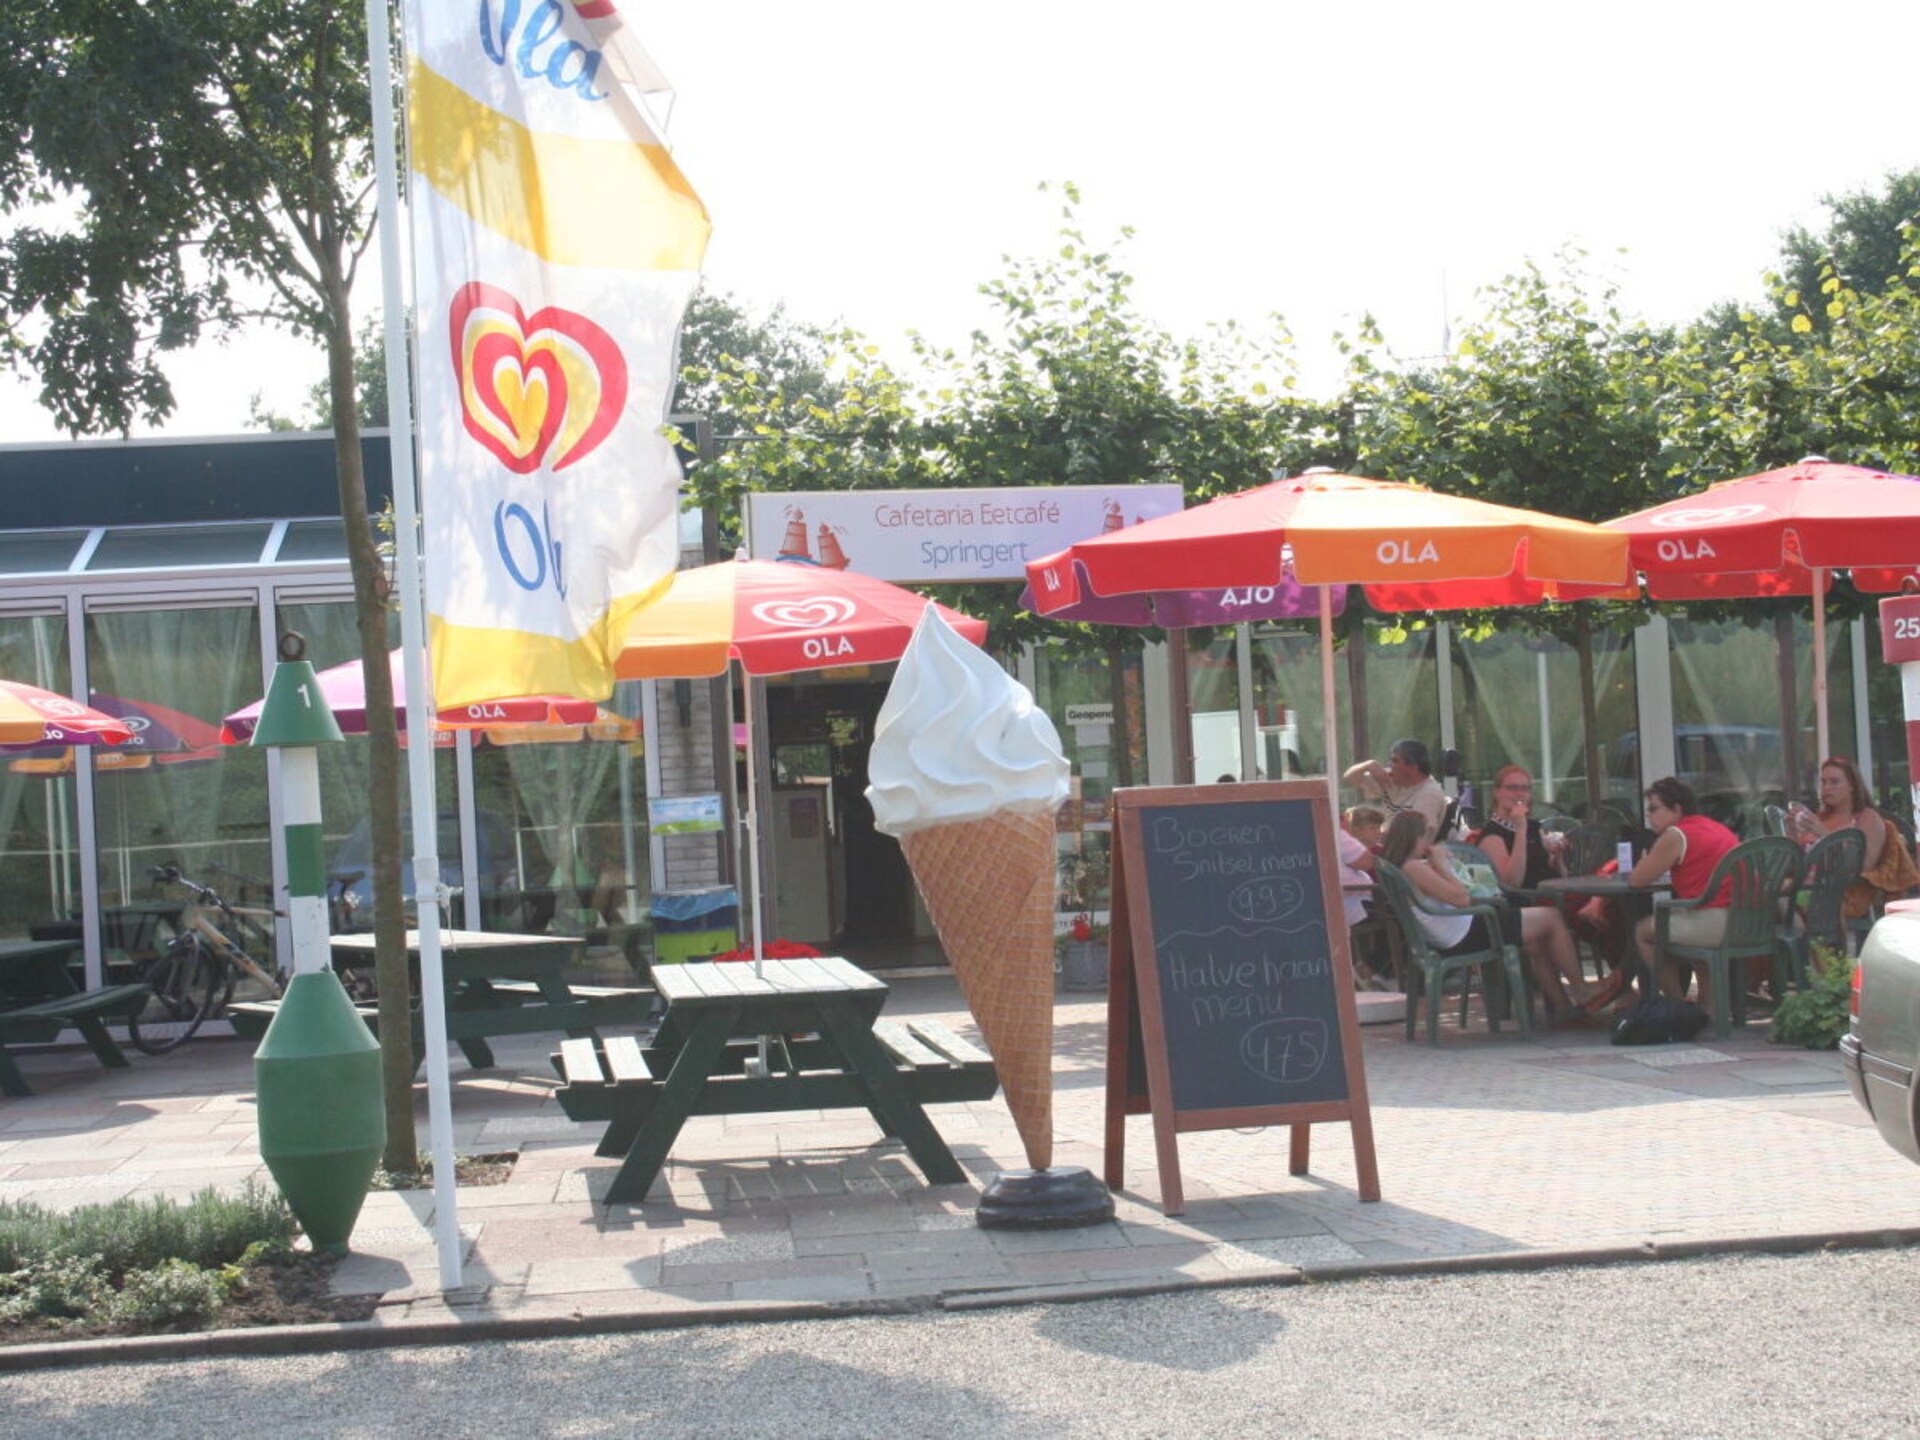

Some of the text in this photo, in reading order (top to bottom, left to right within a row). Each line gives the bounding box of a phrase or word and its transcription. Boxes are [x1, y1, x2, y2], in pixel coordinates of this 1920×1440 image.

[874, 500, 1061, 528] Cafetaria Eetcafé
[921, 540, 1029, 569] Springert
[1376, 540, 1440, 565] OLA
[1657, 539, 1716, 562] OLA
[803, 636, 855, 660] OLA
[297, 684, 311, 708] 1
[468, 704, 507, 719] OLA
[1261, 851, 1314, 872] menu
[1169, 951, 1257, 993] Halve
[1191, 991, 1287, 1028] menu
